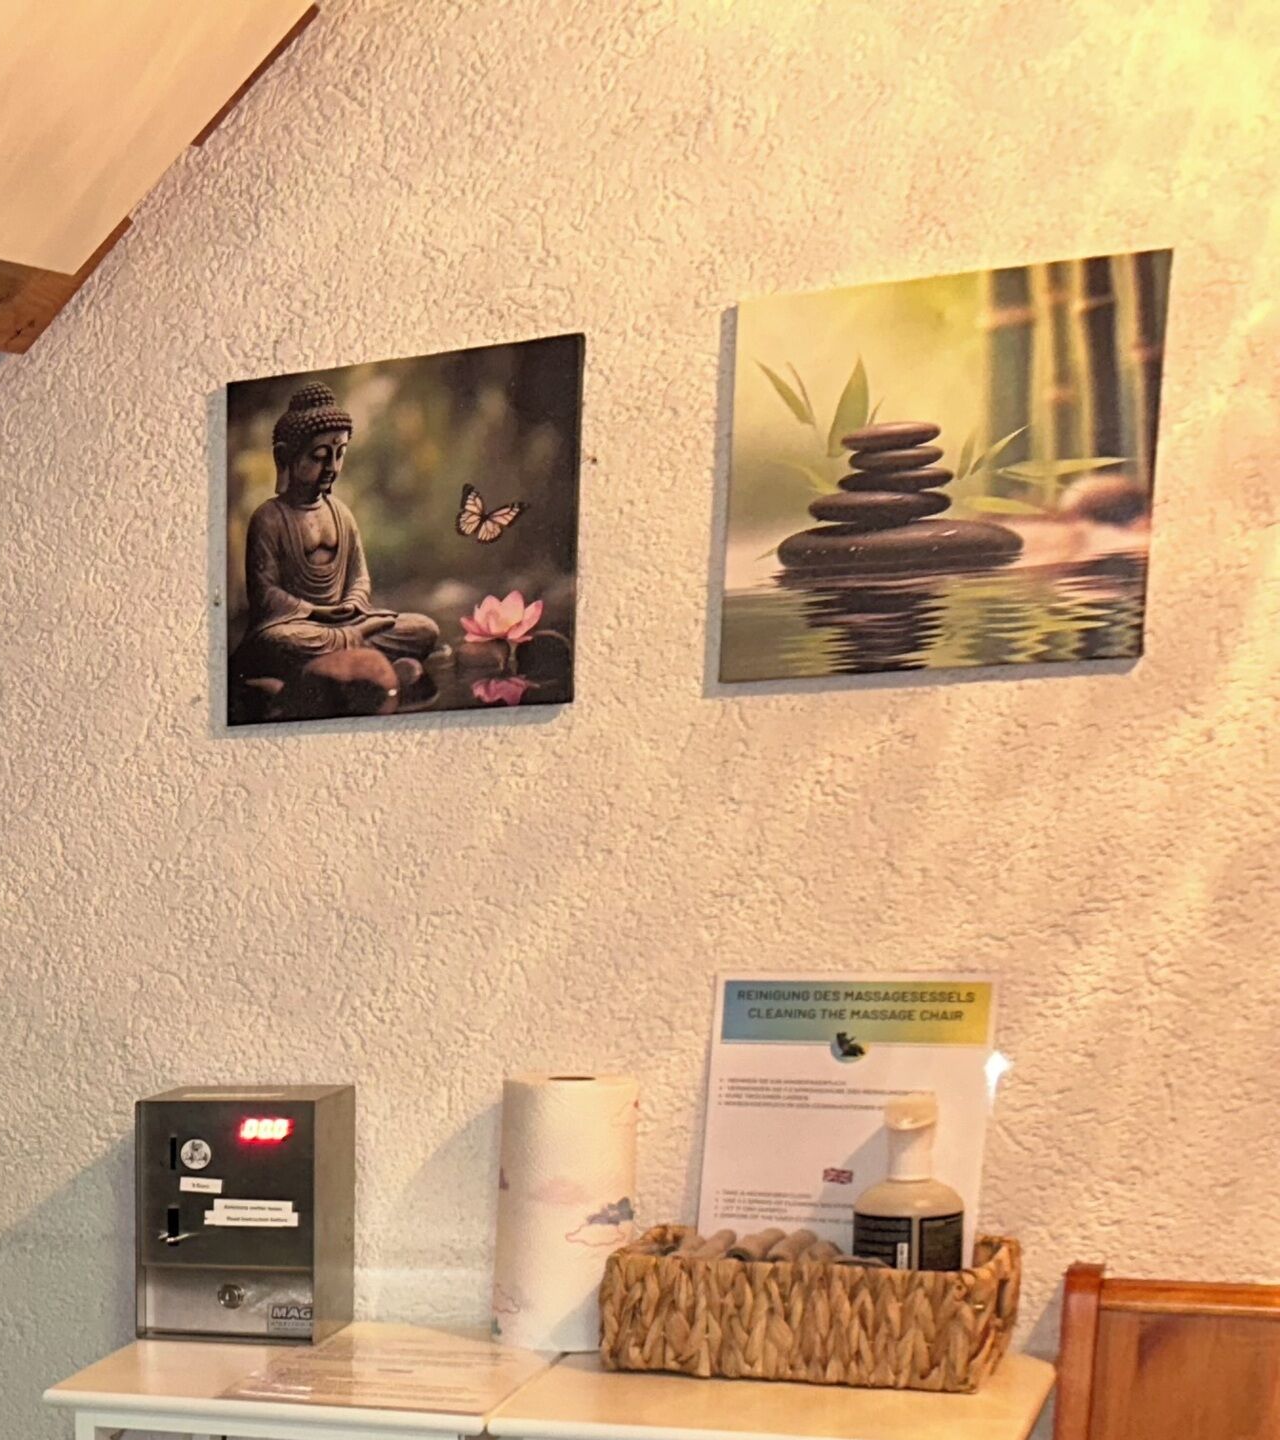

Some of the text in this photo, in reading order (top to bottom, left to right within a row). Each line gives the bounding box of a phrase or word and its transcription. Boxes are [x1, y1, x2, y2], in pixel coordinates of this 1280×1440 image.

[736, 989, 976, 1004] REINIGUNG DES MASSAGESESSELS
[747, 1007, 965, 1022] CLEANING THE MASSAGE CHAIR
